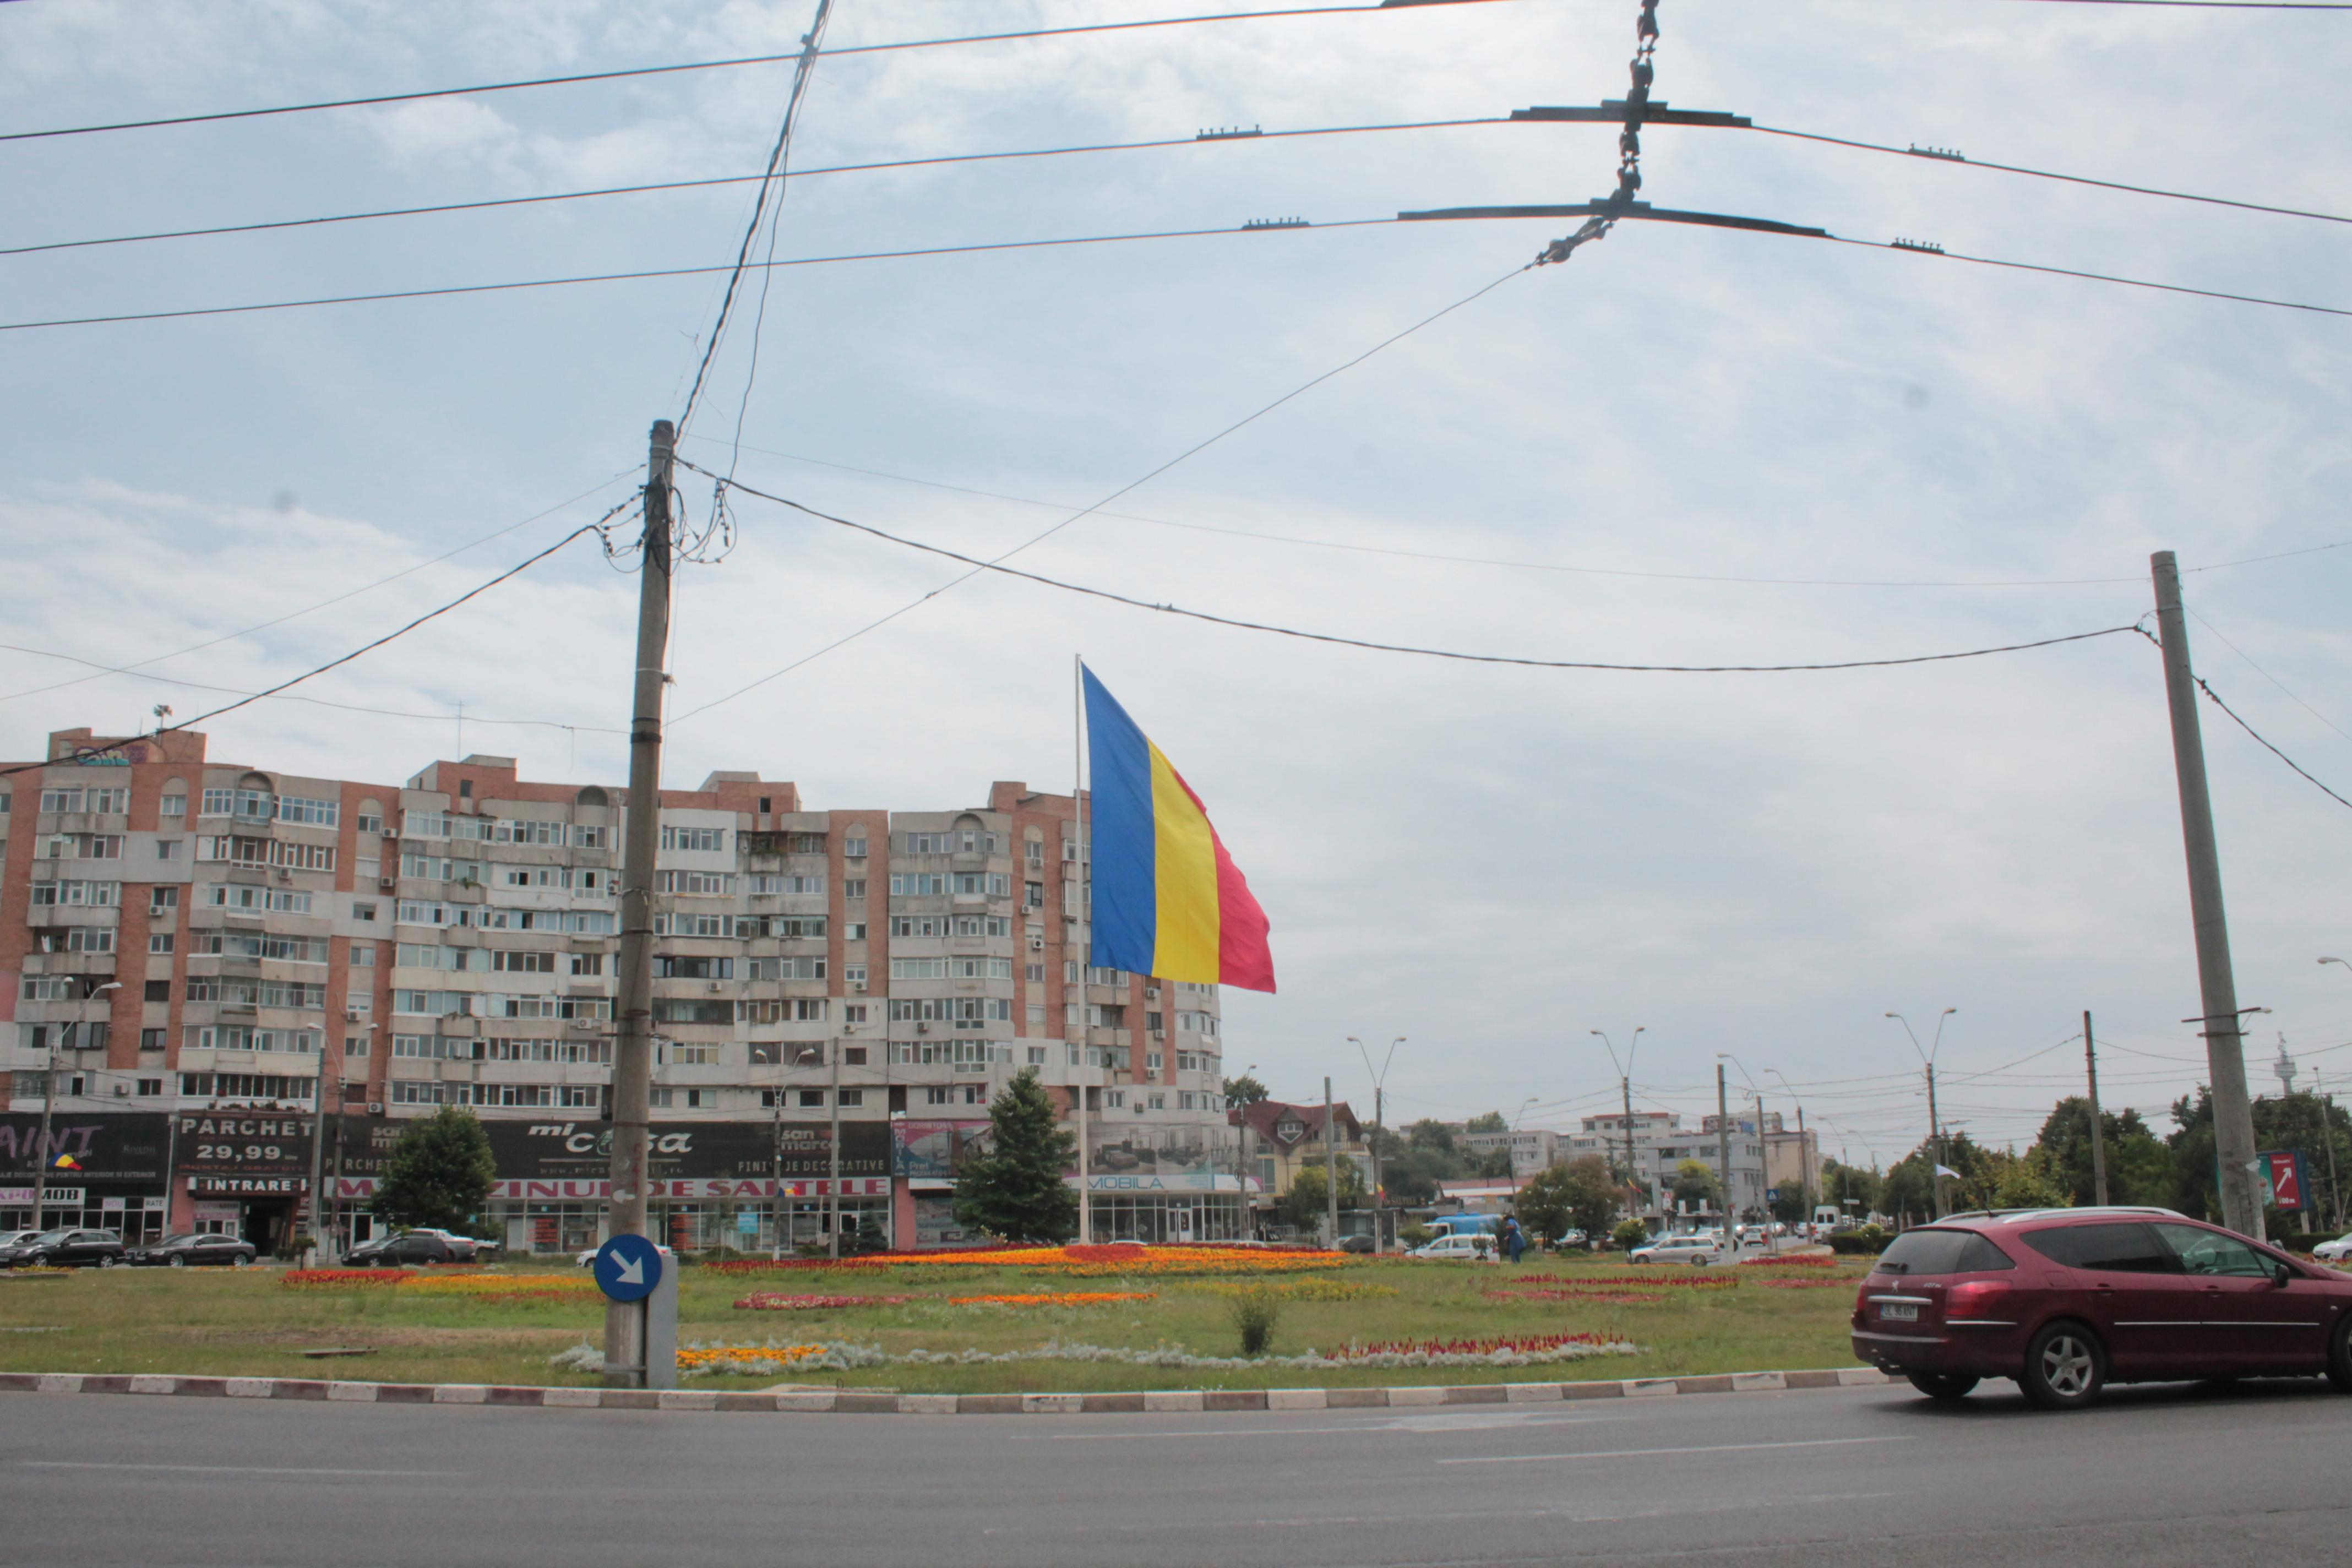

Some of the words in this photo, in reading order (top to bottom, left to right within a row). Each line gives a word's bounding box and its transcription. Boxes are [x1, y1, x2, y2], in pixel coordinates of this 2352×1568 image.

[181, 1119, 315, 1136] PARCHET
[528, 1123, 575, 1136] mi
[782, 1130, 814, 1140] san
[197, 1145, 281, 1162] 29,99
[324, 1158, 392, 1171] PRCHET
[738, 1161, 798, 1172] FINIJE
[207, 1179, 291, 1191] INTRARE
[1087, 1177, 1164, 1190] MOBILA
